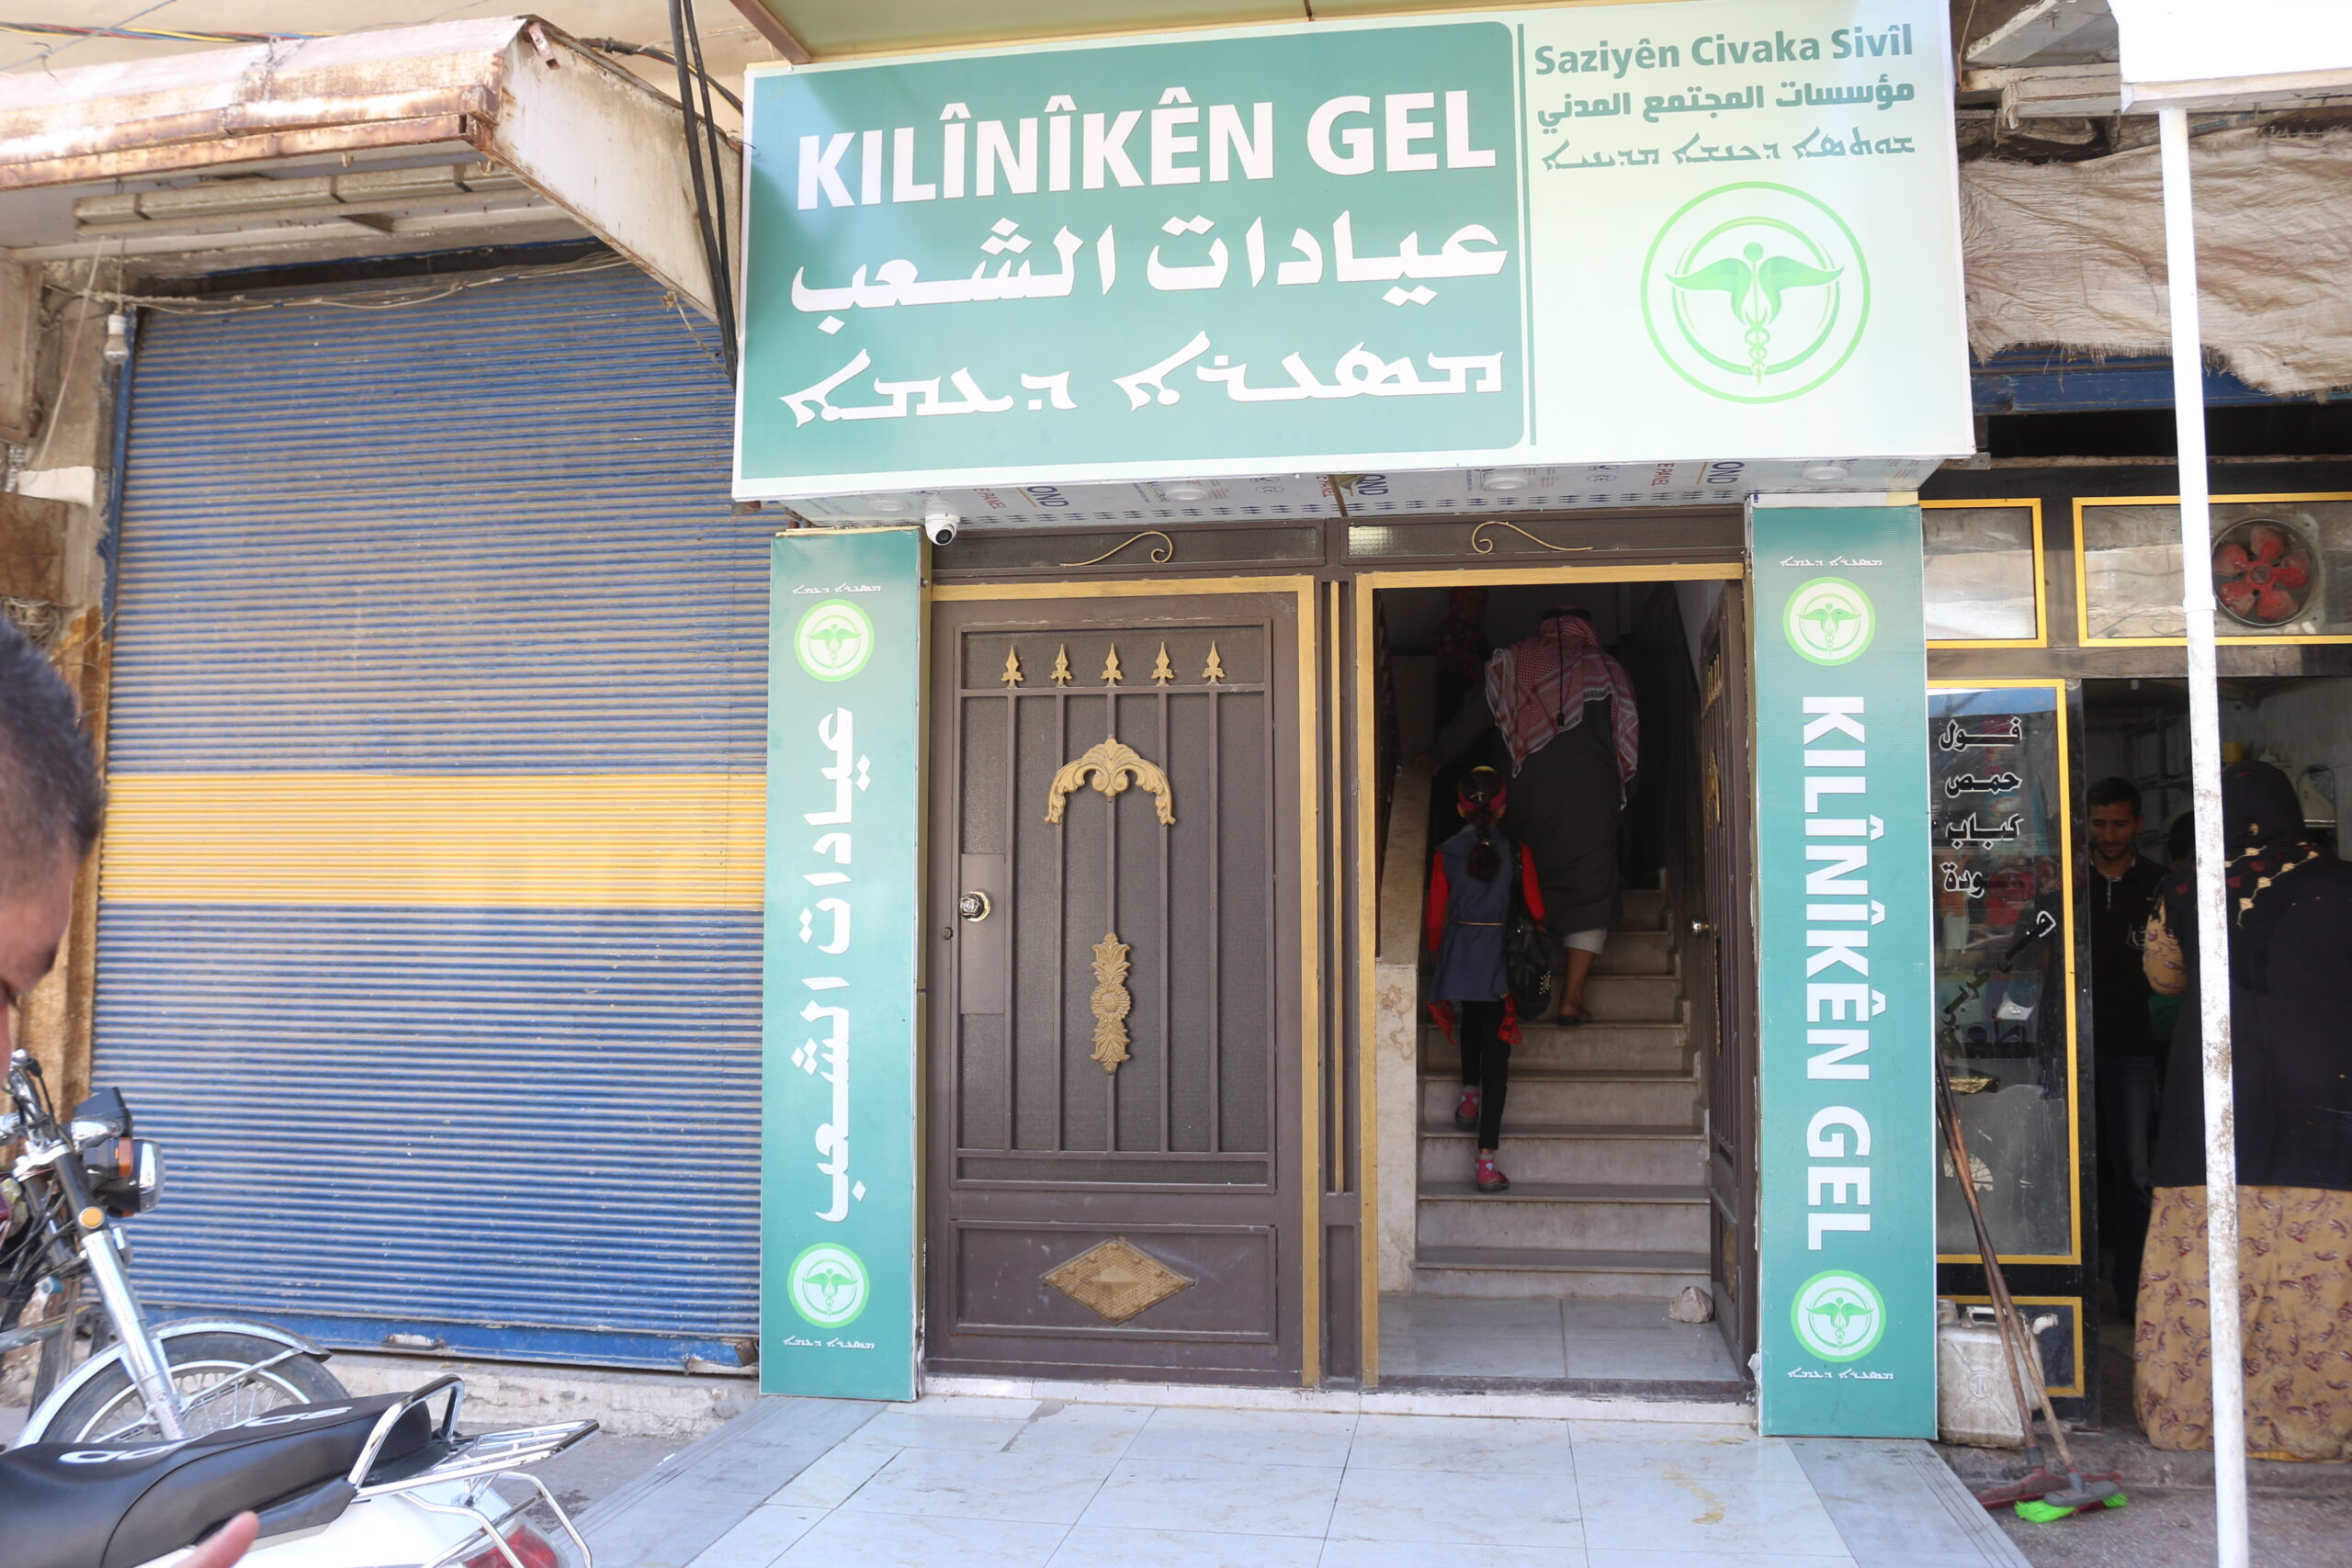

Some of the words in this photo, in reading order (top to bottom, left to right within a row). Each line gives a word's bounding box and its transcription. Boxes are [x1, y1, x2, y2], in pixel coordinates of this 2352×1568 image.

[1534, 38, 1680, 80] Saziyên
[1691, 30, 1820, 66] Civaka
[1830, 23, 1913, 60] Sivîl
[1537, 92, 1632, 135] المدني
[1642, 85, 1765, 123] المجتمع
[1775, 73, 1916, 111] مؤسسات
[797, 86, 1274, 211] KILÎNÎKÊN
[1306, 89, 1498, 176] GEL
[791, 217, 1118, 334] الشعب
[1146, 209, 1509, 309] عيادات
[1939, 716, 2022, 752] فول
[1945, 772, 2022, 798] حمص
[798, 706, 871, 955] عيادات
[1945, 811, 2024, 851] كباب
[1803, 696, 1886, 1080] KILÎNÎKÊN
[790, 976, 867, 1222] الشعب
[1806, 1105, 1871, 1250] GEL
